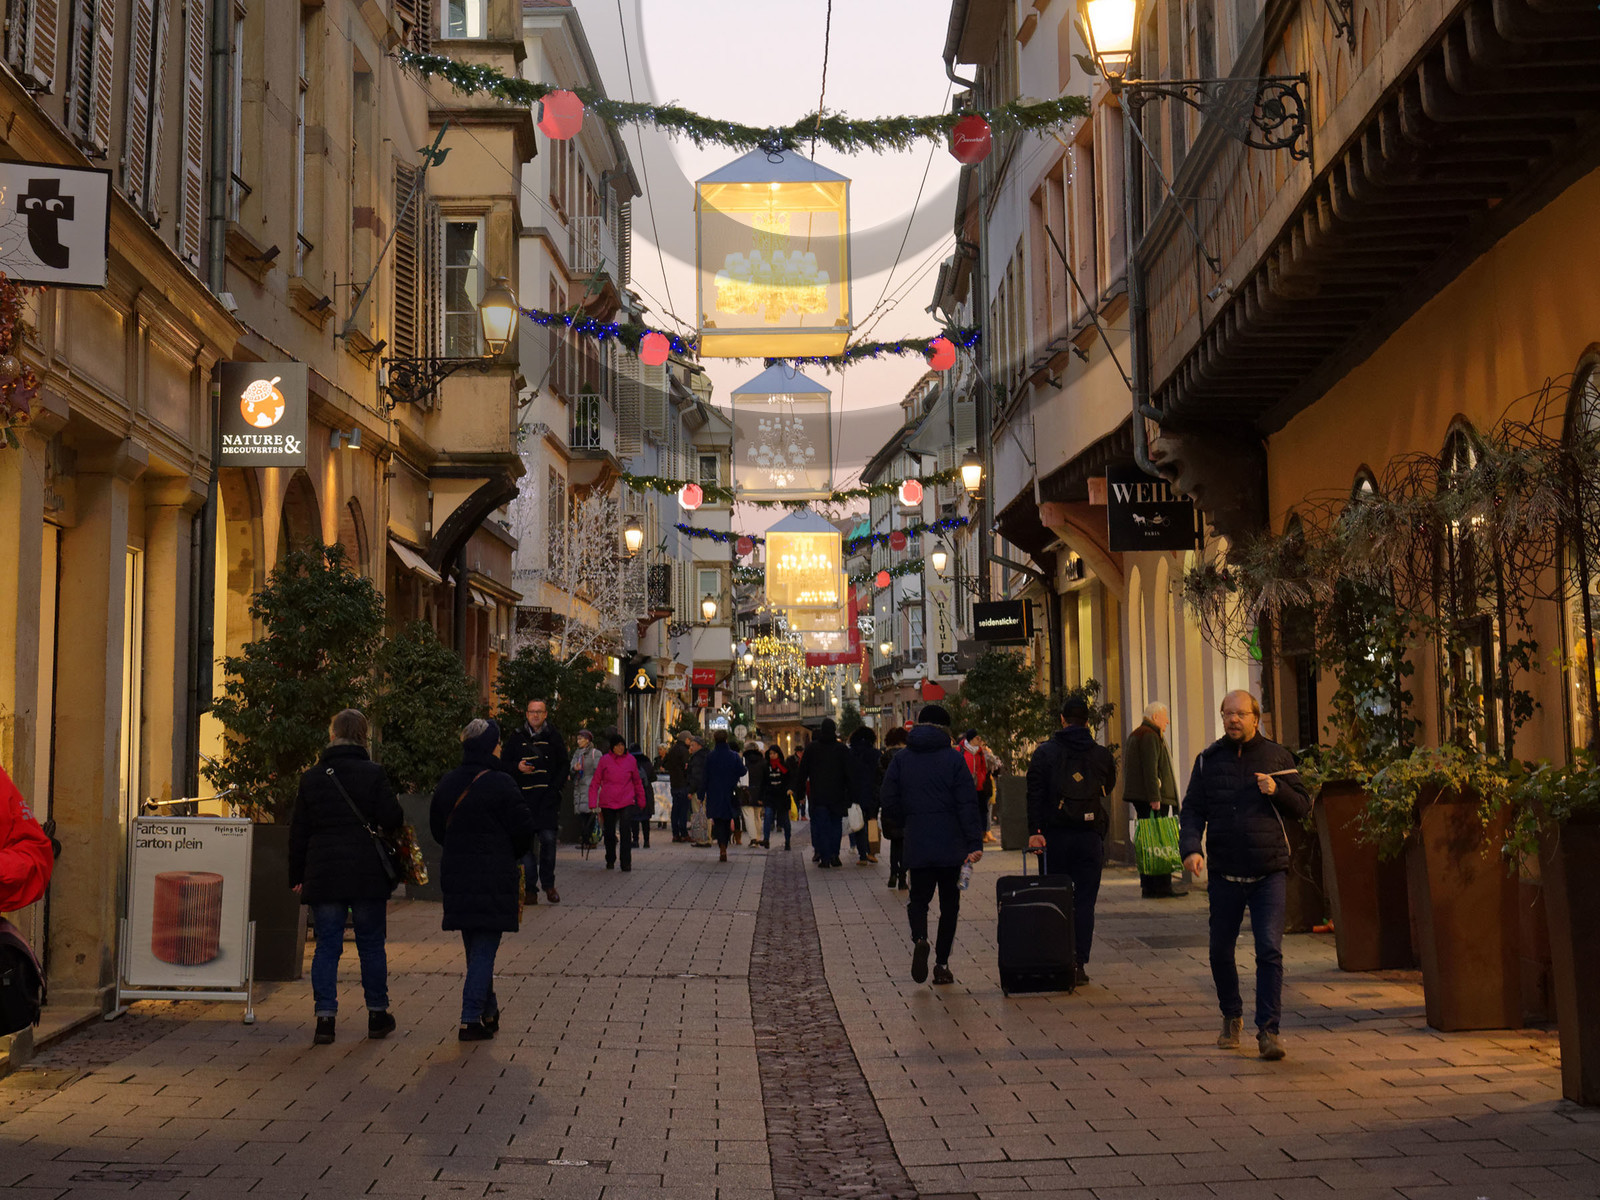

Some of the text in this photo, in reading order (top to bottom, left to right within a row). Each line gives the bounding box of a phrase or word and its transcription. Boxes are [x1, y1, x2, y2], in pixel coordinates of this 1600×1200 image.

[222, 434, 301, 454] NATURE &
[222, 446, 283, 454] DECOUVERTES
[978, 616, 1019, 627] seidensticker
[171, 826, 187, 835] un
[214, 826, 233, 834] flying
[175, 837, 203, 852] plein
